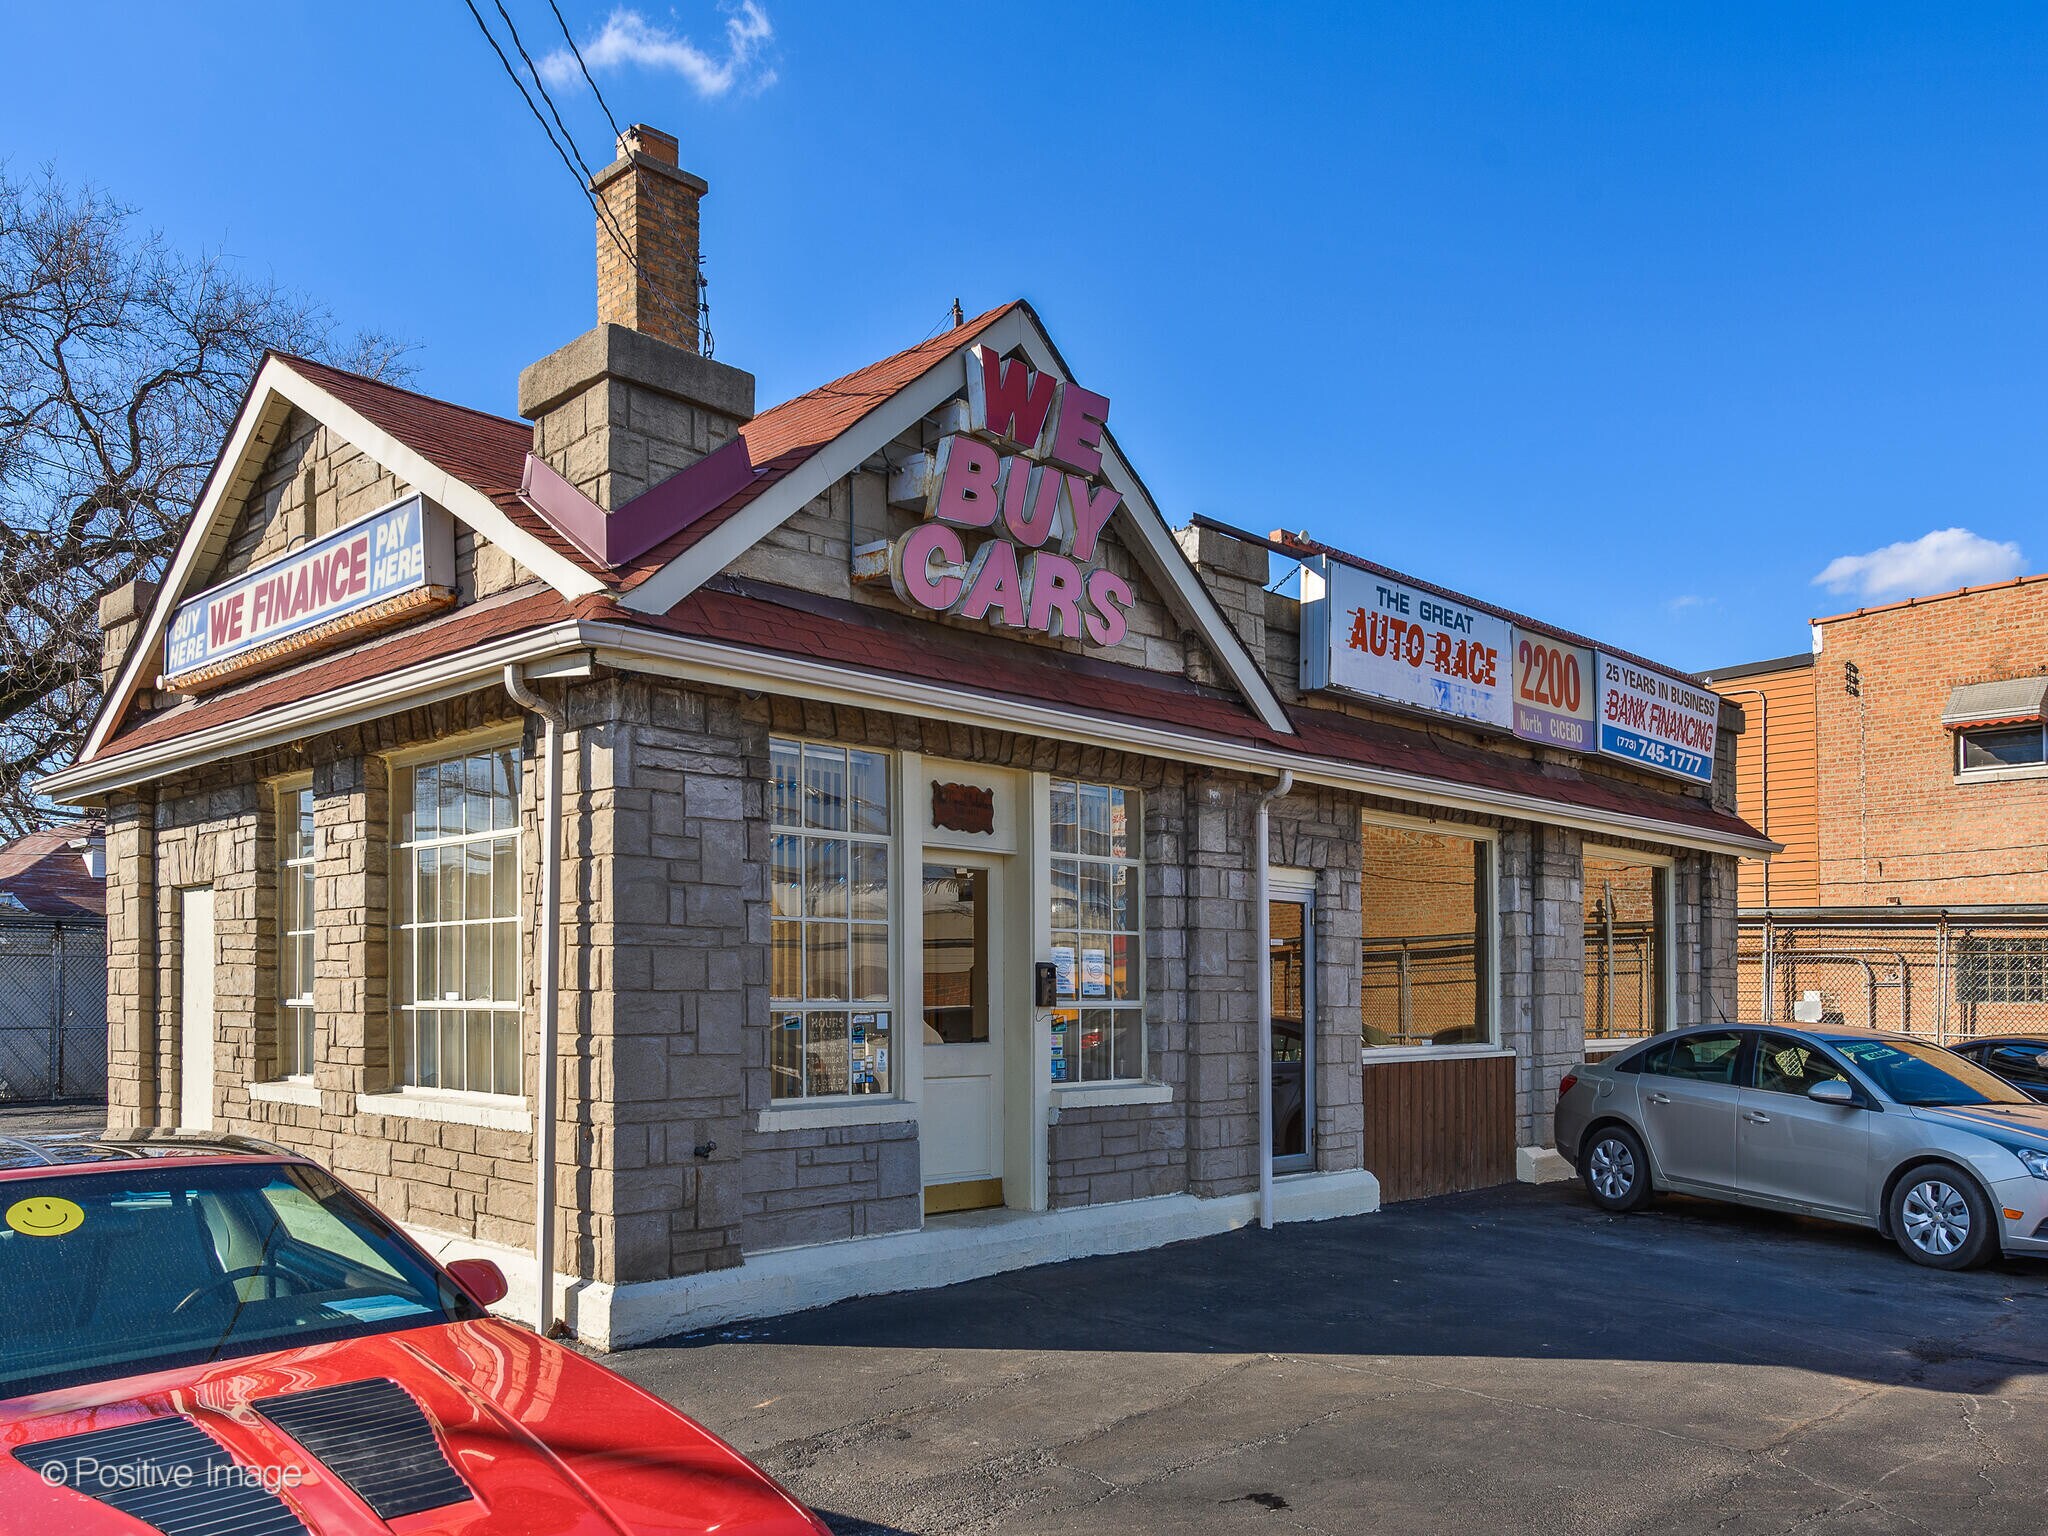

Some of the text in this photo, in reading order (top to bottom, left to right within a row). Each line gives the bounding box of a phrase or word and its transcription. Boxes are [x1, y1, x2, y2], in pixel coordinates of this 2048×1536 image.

[979, 343, 1111, 476] WE
[935, 434, 1123, 562] BUY
[375, 513, 410, 557] PAY
[210, 537, 368, 649] WE FINANCE
[373, 543, 423, 591] HERE
[902, 523, 1135, 646] CARS
[174, 608, 201, 642] BUY
[1375, 585, 1474, 635] THE GREAT
[169, 633, 206, 669] HERE
[1346, 606, 1498, 687] AUTO RACE
[1519, 640, 1580, 713] 2200
[1605, 662, 1715, 717] 25 YEARS IN BUSINESS
[1519, 709, 1583, 744] North CICERO
[1604, 688, 1714, 752] BANK FINANCING
[1616, 735, 1702, 773] (773) 745-1777
